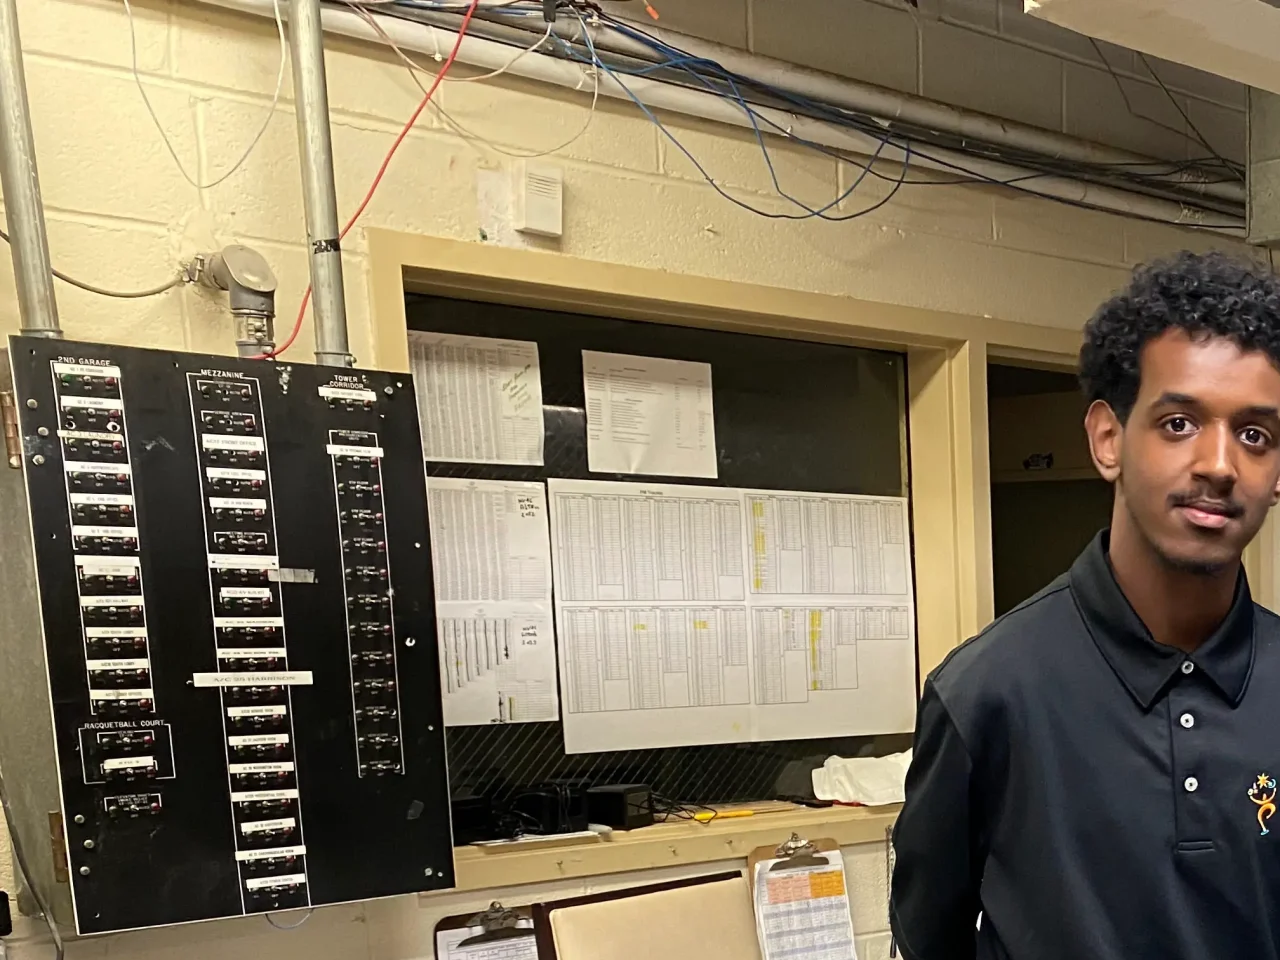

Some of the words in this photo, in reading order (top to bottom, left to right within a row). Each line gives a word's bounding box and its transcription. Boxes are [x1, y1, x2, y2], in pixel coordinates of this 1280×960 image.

[57, 356, 75, 365] 2ND
[78, 358, 111, 367] GARAGE
[200, 369, 244, 379] MEZZANINE
[334, 374, 358, 383] TOWER
[329, 381, 364, 390] CORRIDOR
[84, 720, 138, 729] RACQUETBALL
[140, 719, 165, 727] COURT
